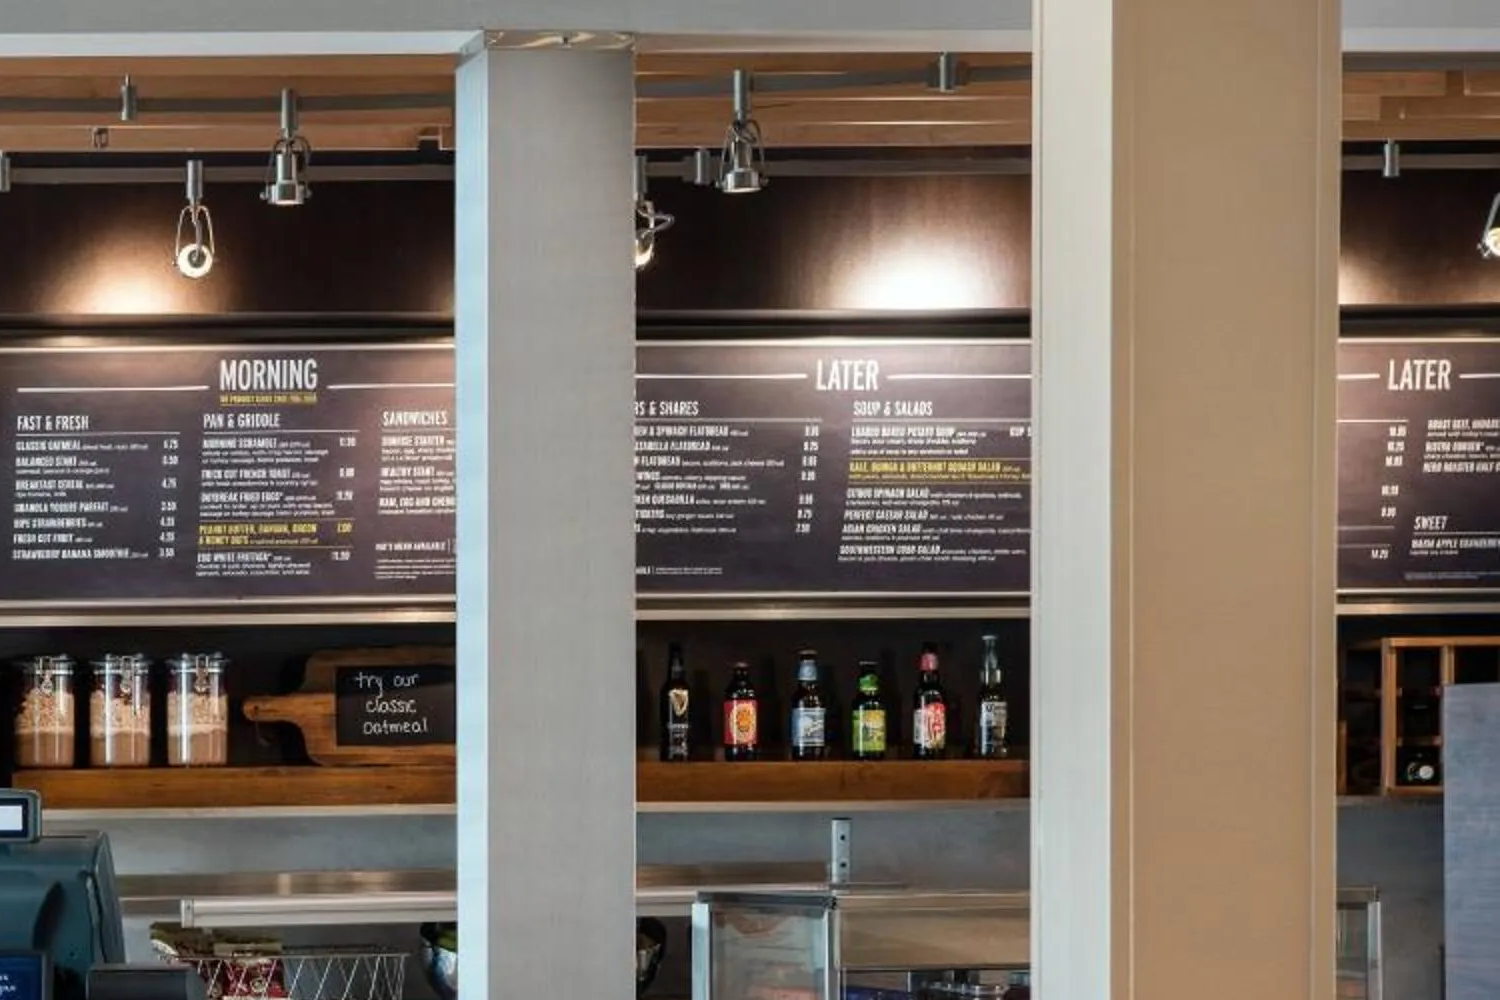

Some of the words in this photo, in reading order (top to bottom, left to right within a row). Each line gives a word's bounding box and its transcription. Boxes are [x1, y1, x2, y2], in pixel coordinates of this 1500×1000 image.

[220, 359, 317, 391] MORNING
[816, 359, 878, 391] LATER
[1388, 359, 1452, 391] LATER
[659, 401, 699, 416] SHARES
[854, 401, 880, 416] SOUP
[895, 401, 933, 416] SALADS
[17, 415, 41, 431] FAST
[56, 415, 89, 431] FRESH
[203, 413, 224, 428] PAN
[238, 413, 280, 428] GRIDDLE
[383, 411, 448, 426] SANDWICHES
[1413, 516, 1448, 530] SWEET
[355, 671, 384, 699] try
[394, 673, 419, 687] our
[366, 698, 417, 713] classic
[363, 716, 428, 735] oatmeal
